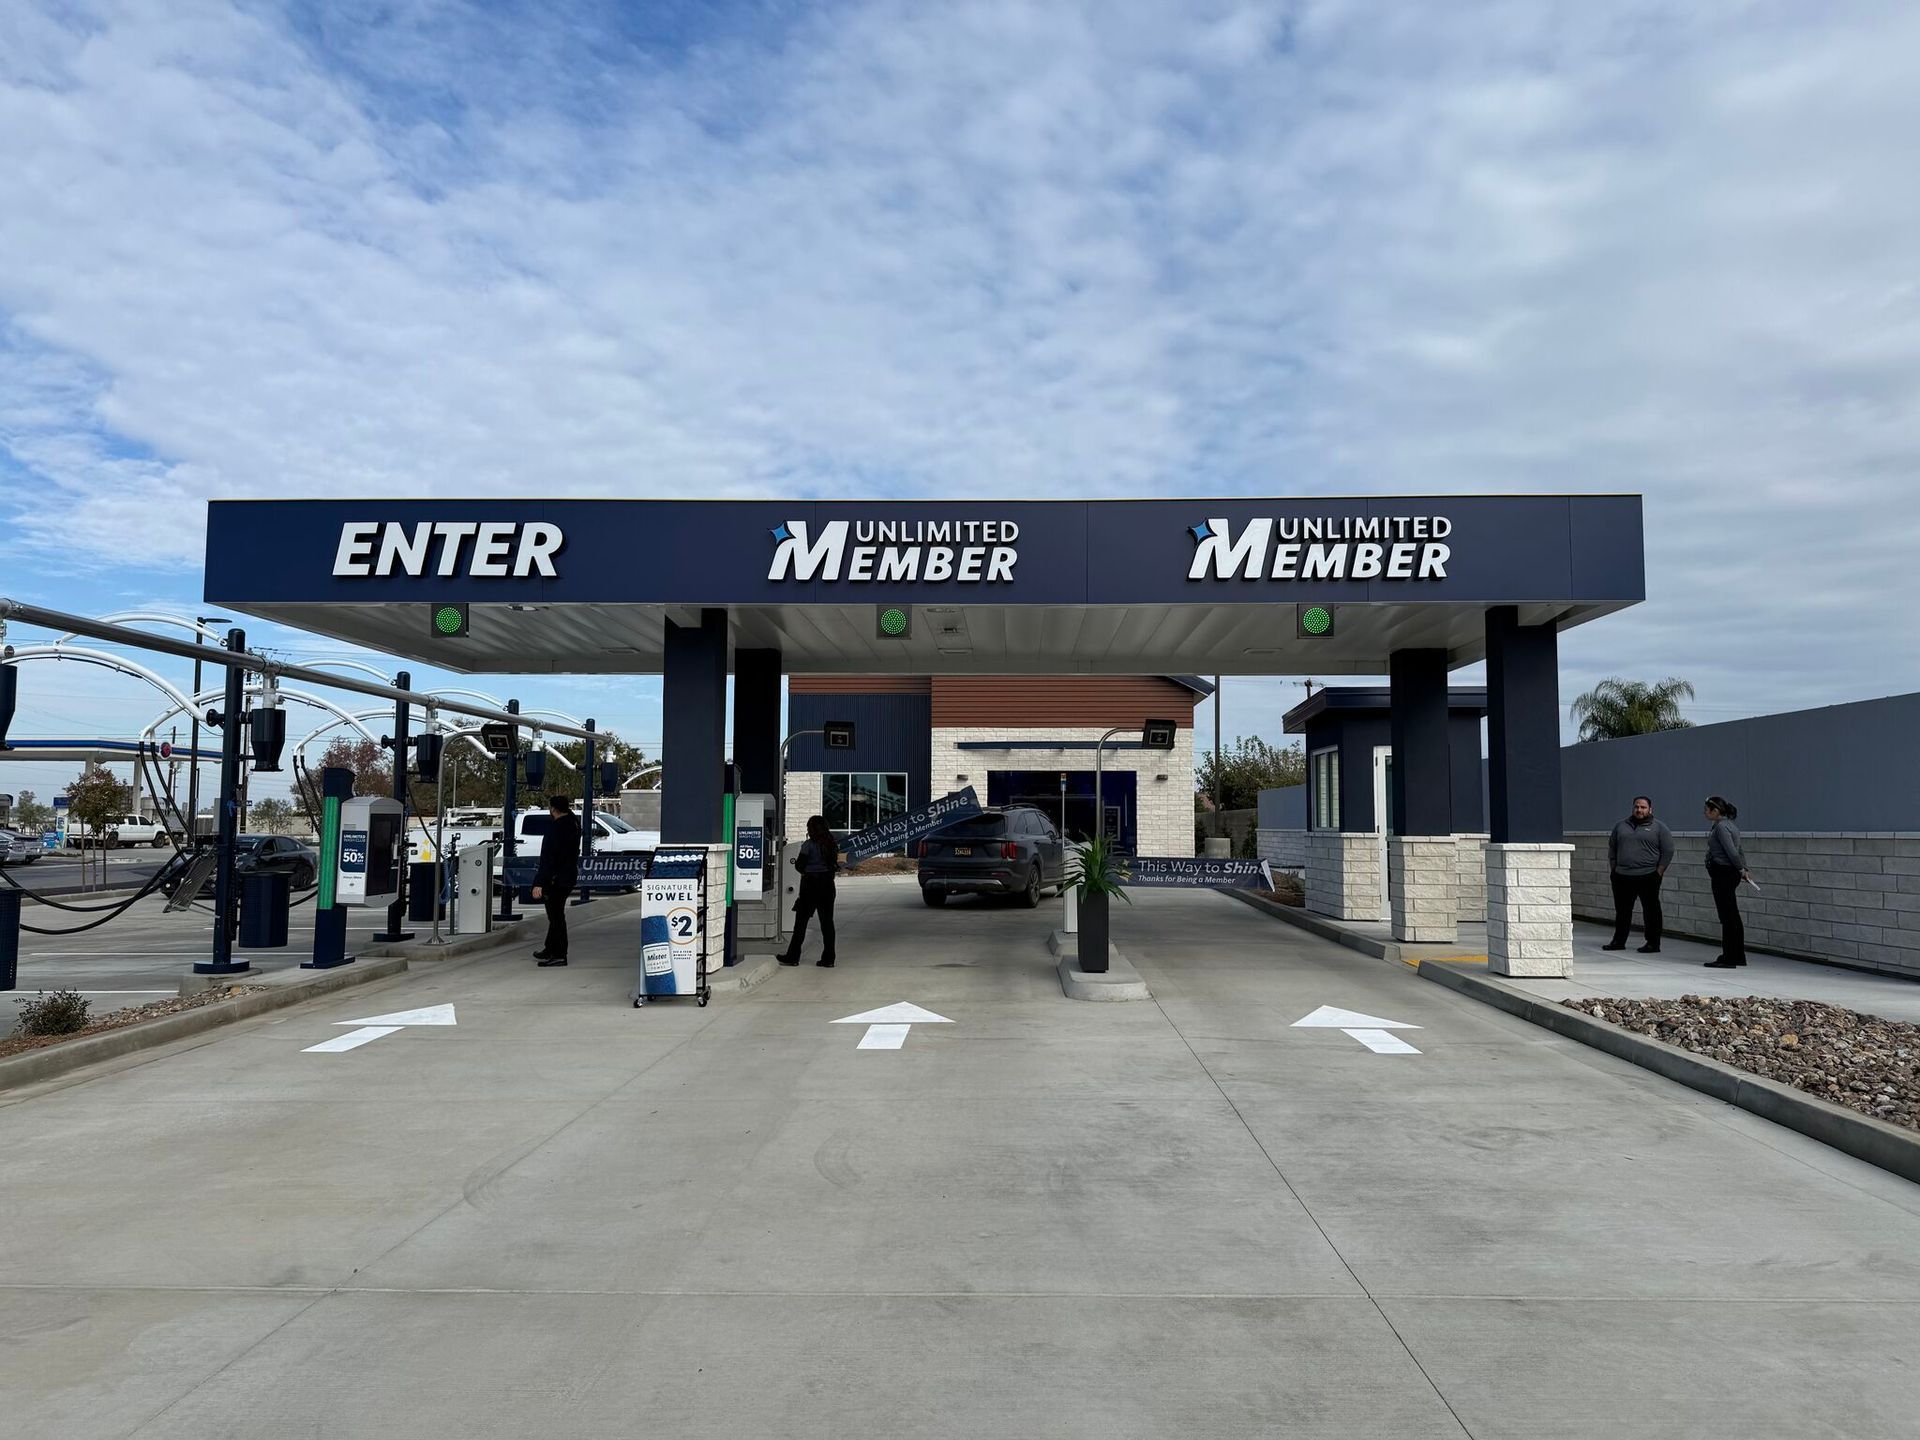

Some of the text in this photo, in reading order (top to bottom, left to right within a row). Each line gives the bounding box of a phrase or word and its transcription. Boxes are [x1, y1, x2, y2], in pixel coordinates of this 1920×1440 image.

[856, 520, 1019, 543] UNLIMITED
[1279, 517, 1451, 539] UNLIMITED
[332, 522, 563, 576] ENTER
[768, 521, 1018, 581] MEMBER
[1188, 518, 1450, 579] MEMBER
[848, 796, 968, 848] This Way to Shine
[855, 844, 879, 858] Thanks
[879, 840, 889, 848] for
[890, 832, 909, 844] Being
[915, 818, 943, 834] Member
[583, 858, 647, 871] Unlimite
[1138, 860, 1167, 872] This
[1170, 860, 1202, 876] Way
[1204, 862, 1220, 873] to
[625, 873, 646, 881] Today
[1164, 875, 1176, 883] for
[1177, 875, 1197, 884] Being
[1204, 876, 1236, 884] Member
[646, 892, 693, 902] TOWEL
[671, 915, 693, 937] $2
